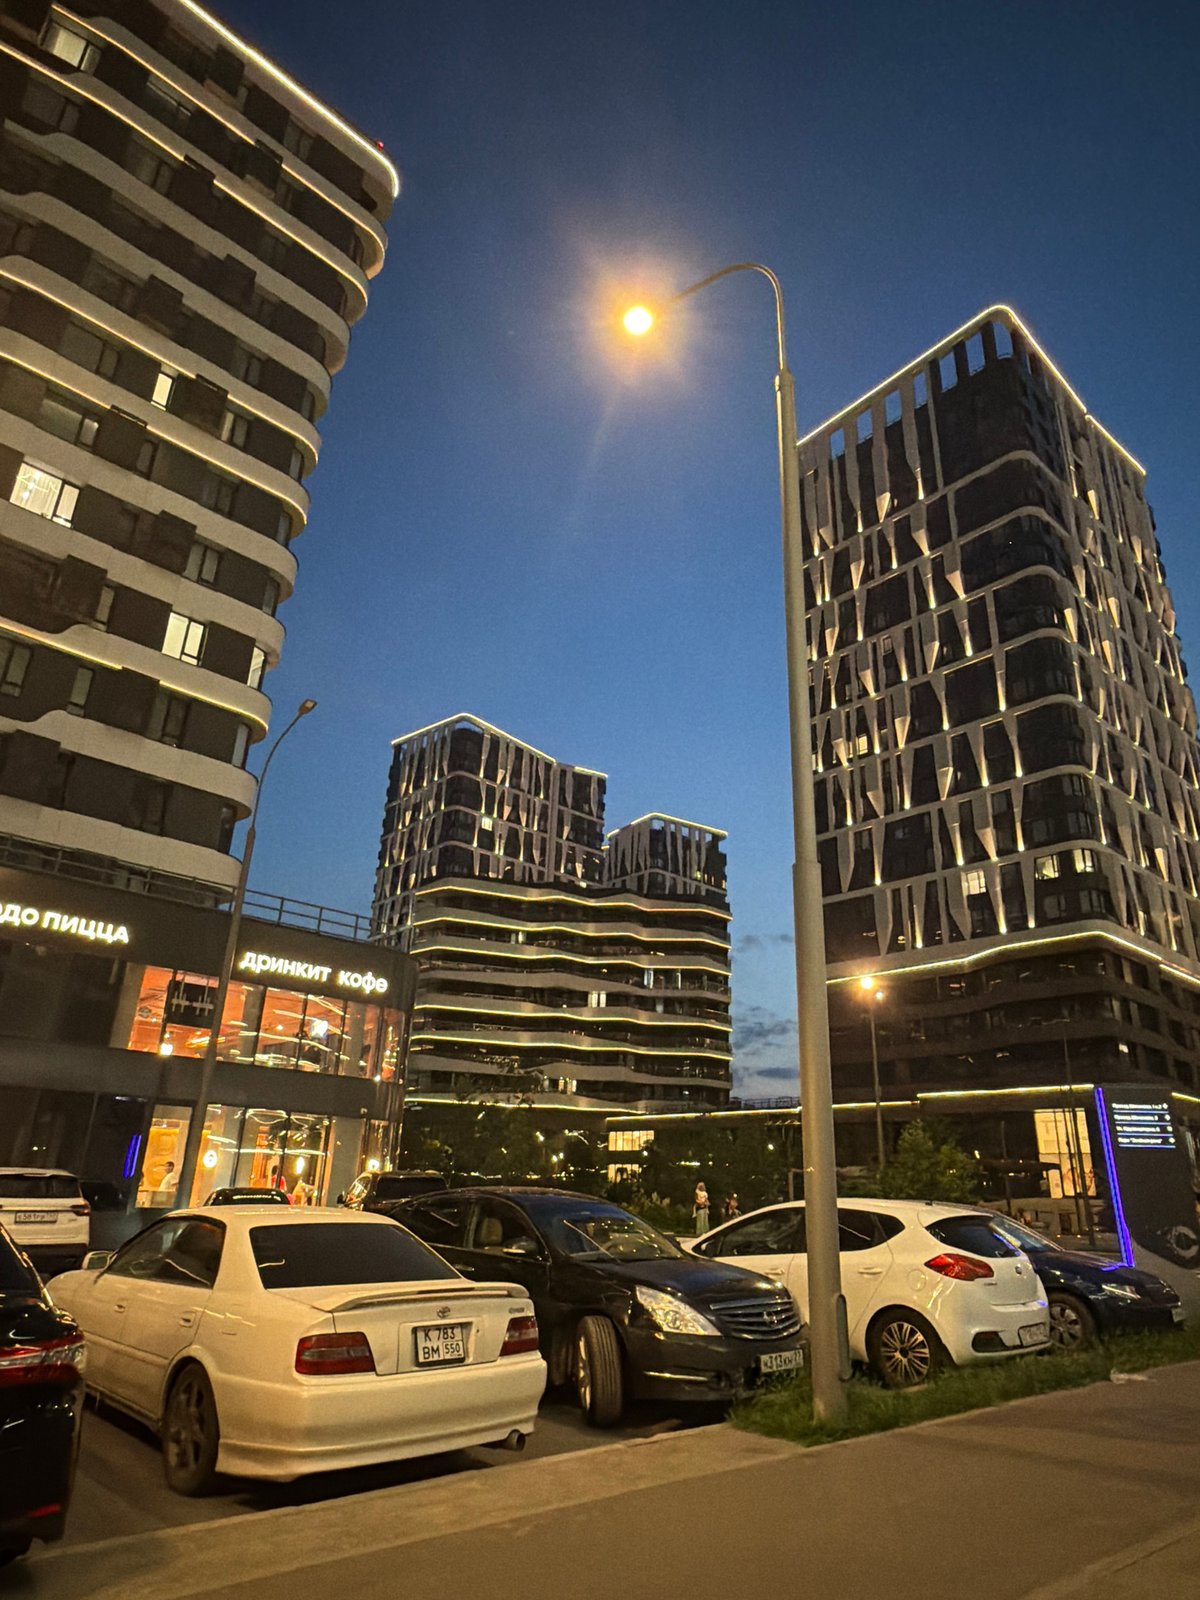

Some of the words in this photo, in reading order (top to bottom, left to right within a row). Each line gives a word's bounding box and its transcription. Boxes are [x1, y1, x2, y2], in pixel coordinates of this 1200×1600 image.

[0, 903, 39, 926] ДО
[42, 911, 129, 944] ПИЦЦА
[338, 970, 388, 994] кофе
[445, 1343, 461, 1354] 550
